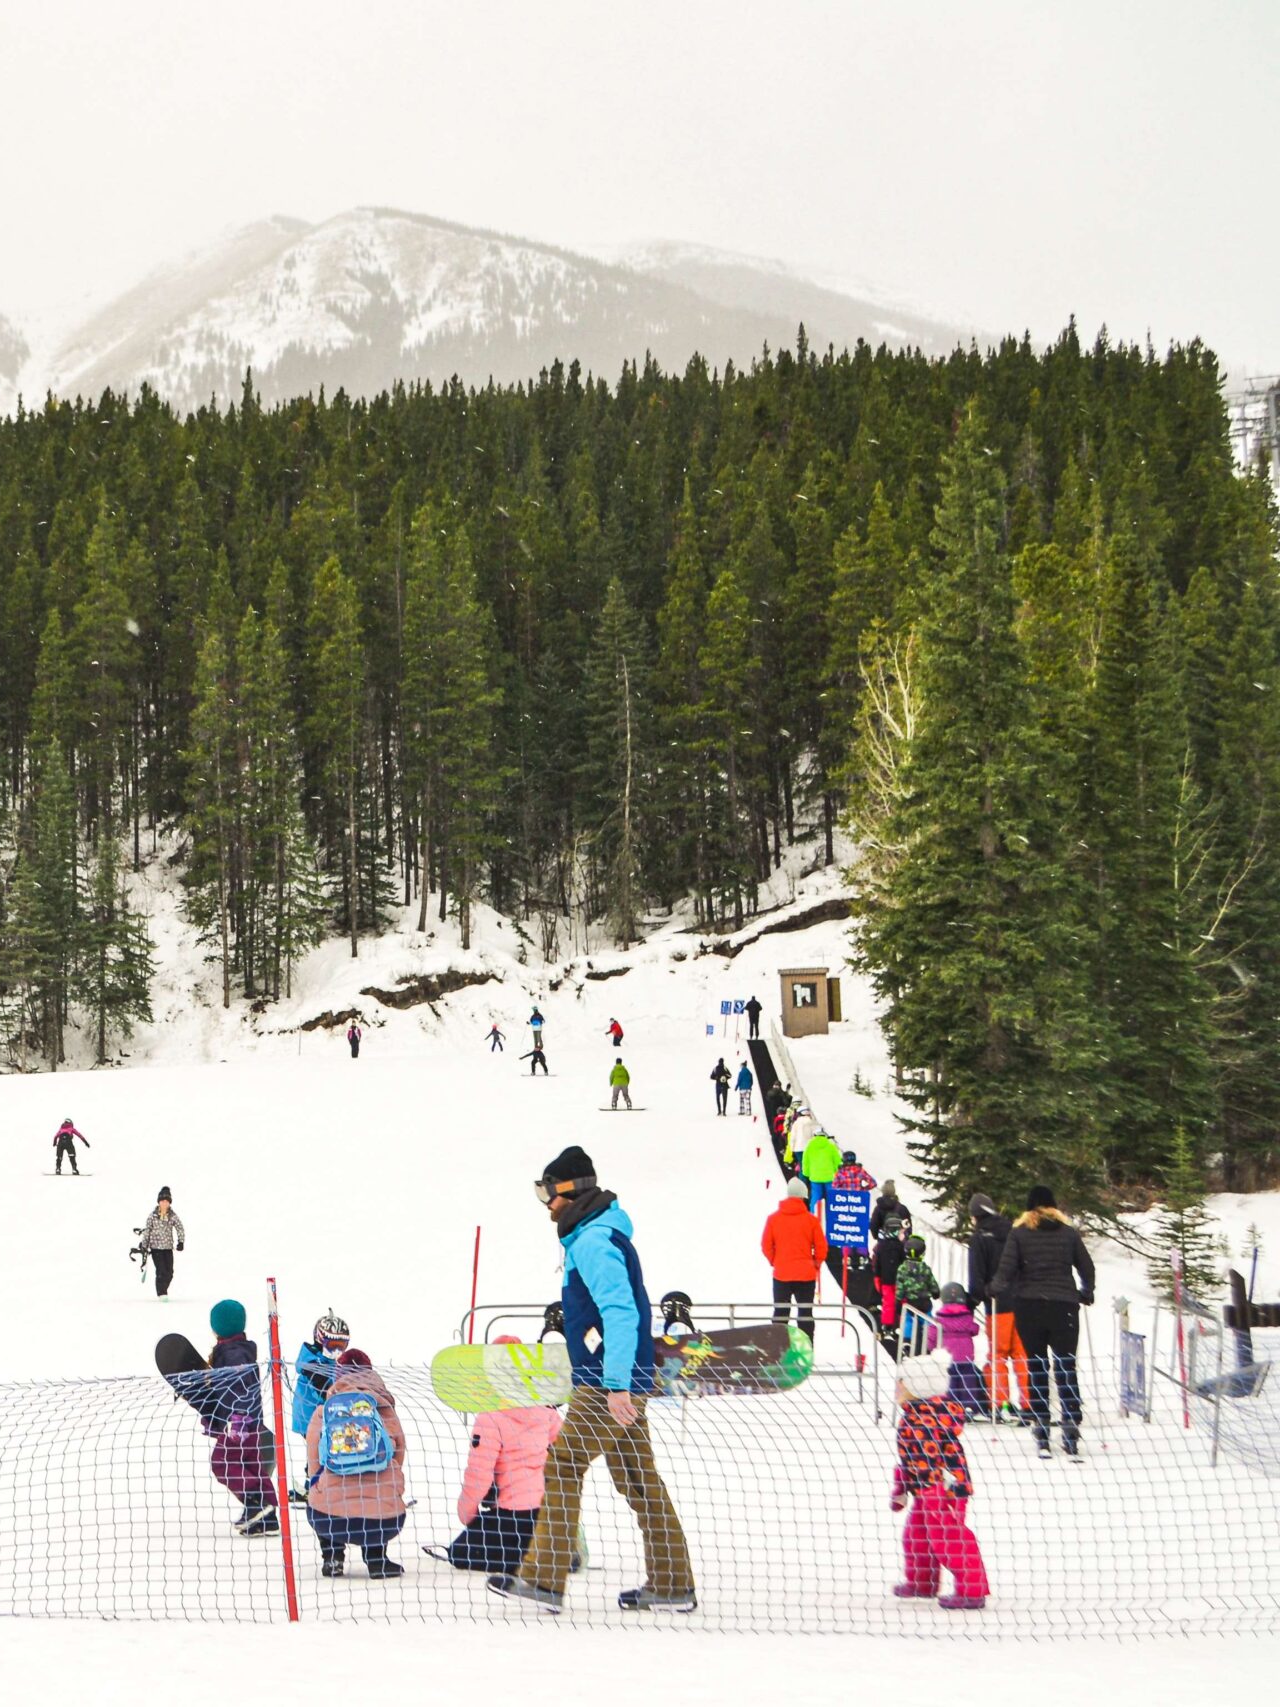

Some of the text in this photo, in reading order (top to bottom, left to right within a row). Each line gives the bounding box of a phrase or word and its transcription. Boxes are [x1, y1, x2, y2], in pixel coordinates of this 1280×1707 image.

[835, 1194, 861, 1204] Do Not
[830, 1204, 866, 1214] Load Until
[838, 1214, 858, 1222] Skier
[834, 1223, 860, 1232] Passes
[830, 1233, 864, 1243] This Point
